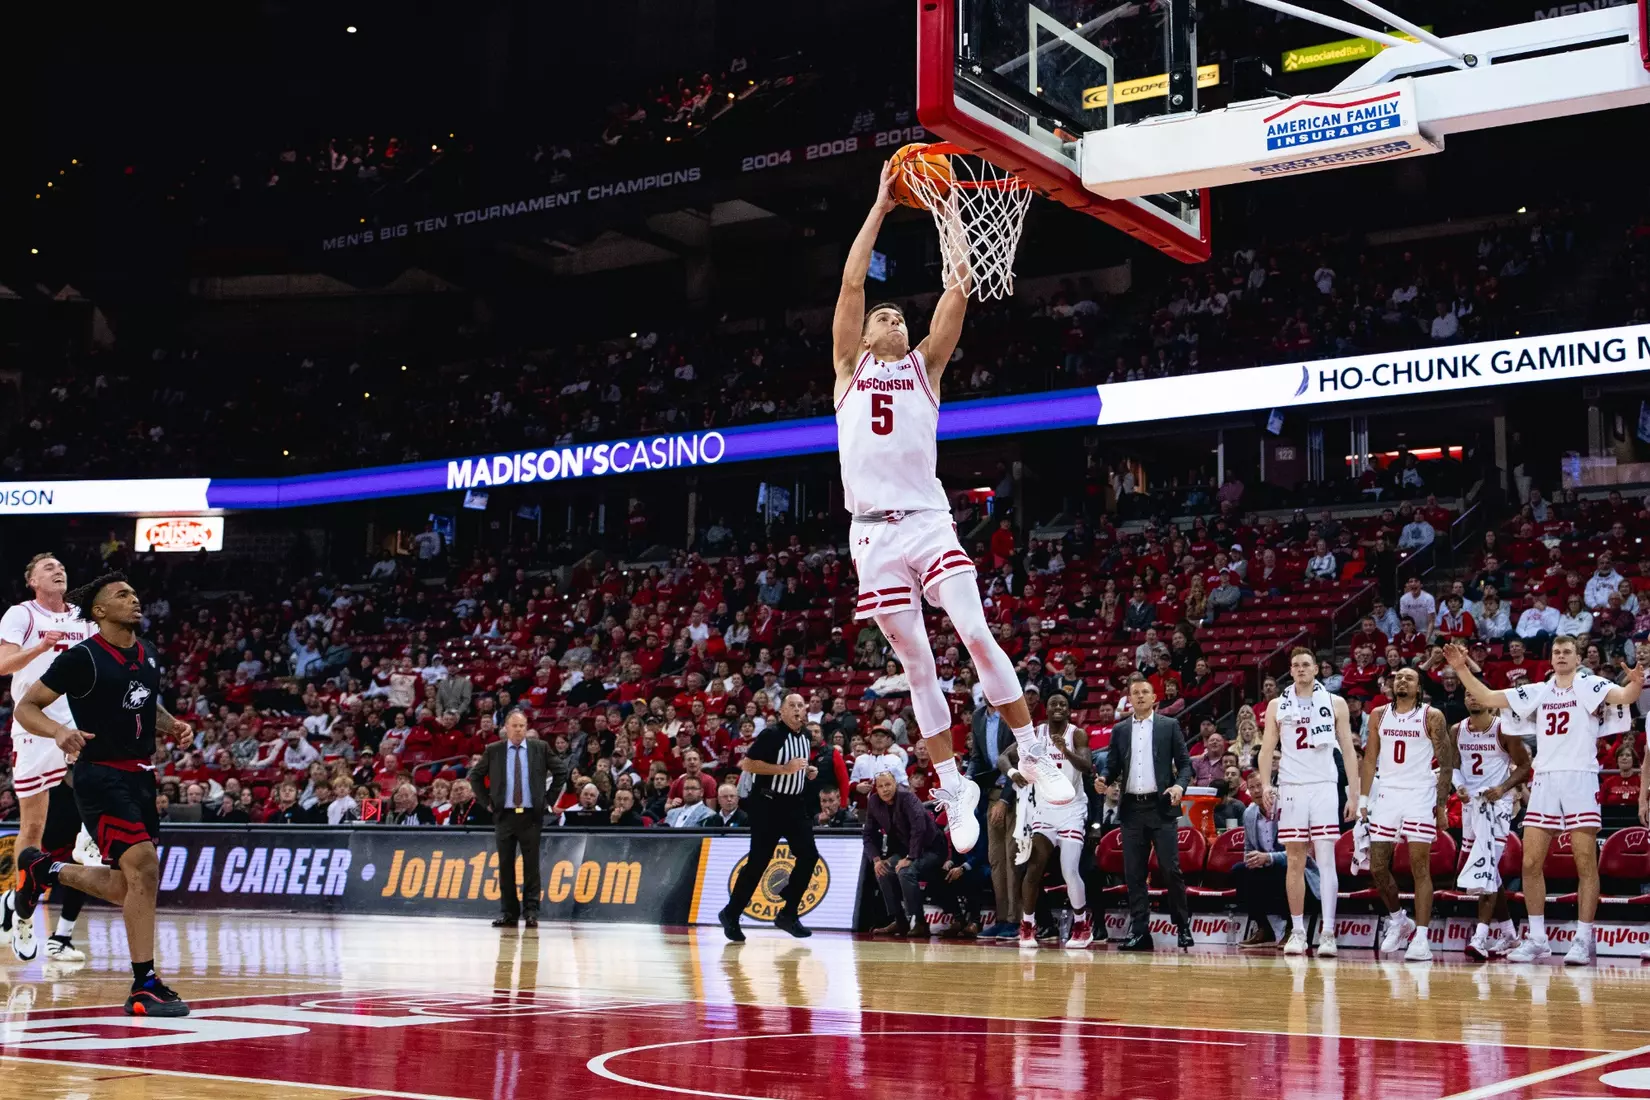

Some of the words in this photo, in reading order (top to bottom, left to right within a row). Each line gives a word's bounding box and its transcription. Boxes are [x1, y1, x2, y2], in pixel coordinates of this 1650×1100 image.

[1121, 81, 1170, 96] COOPE
[1267, 113, 1341, 137] AMERICAN
[1347, 101, 1399, 123] FAMILY
[1277, 118, 1391, 147] INSURANCE
[741, 150, 792, 171] 2004
[806, 137, 858, 160] 2008
[875, 126, 925, 147] 2015
[322, 230, 374, 250] MEN'S
[380, 224, 408, 240] BIG
[415, 216, 448, 233] TEN
[454, 189, 581, 226] TOURNAMENT
[587, 167, 701, 201] CHAMPIONS
[1319, 353, 1482, 392] HO-CHUNK
[1491, 338, 1627, 374] GAMING
[871, 393, 893, 435] 5
[1542, 700, 1577, 710] WISCONSIN
[1383, 728, 1420, 738] WISCONSIN
[1545, 711, 1570, 736] 32
[1393, 740, 1406, 764] 0
[1460, 743, 1496, 751] WISCONSIN
[1471, 752, 1484, 775] 2
[188, 847, 215, 892] A
[220, 846, 352, 895] CAREER
